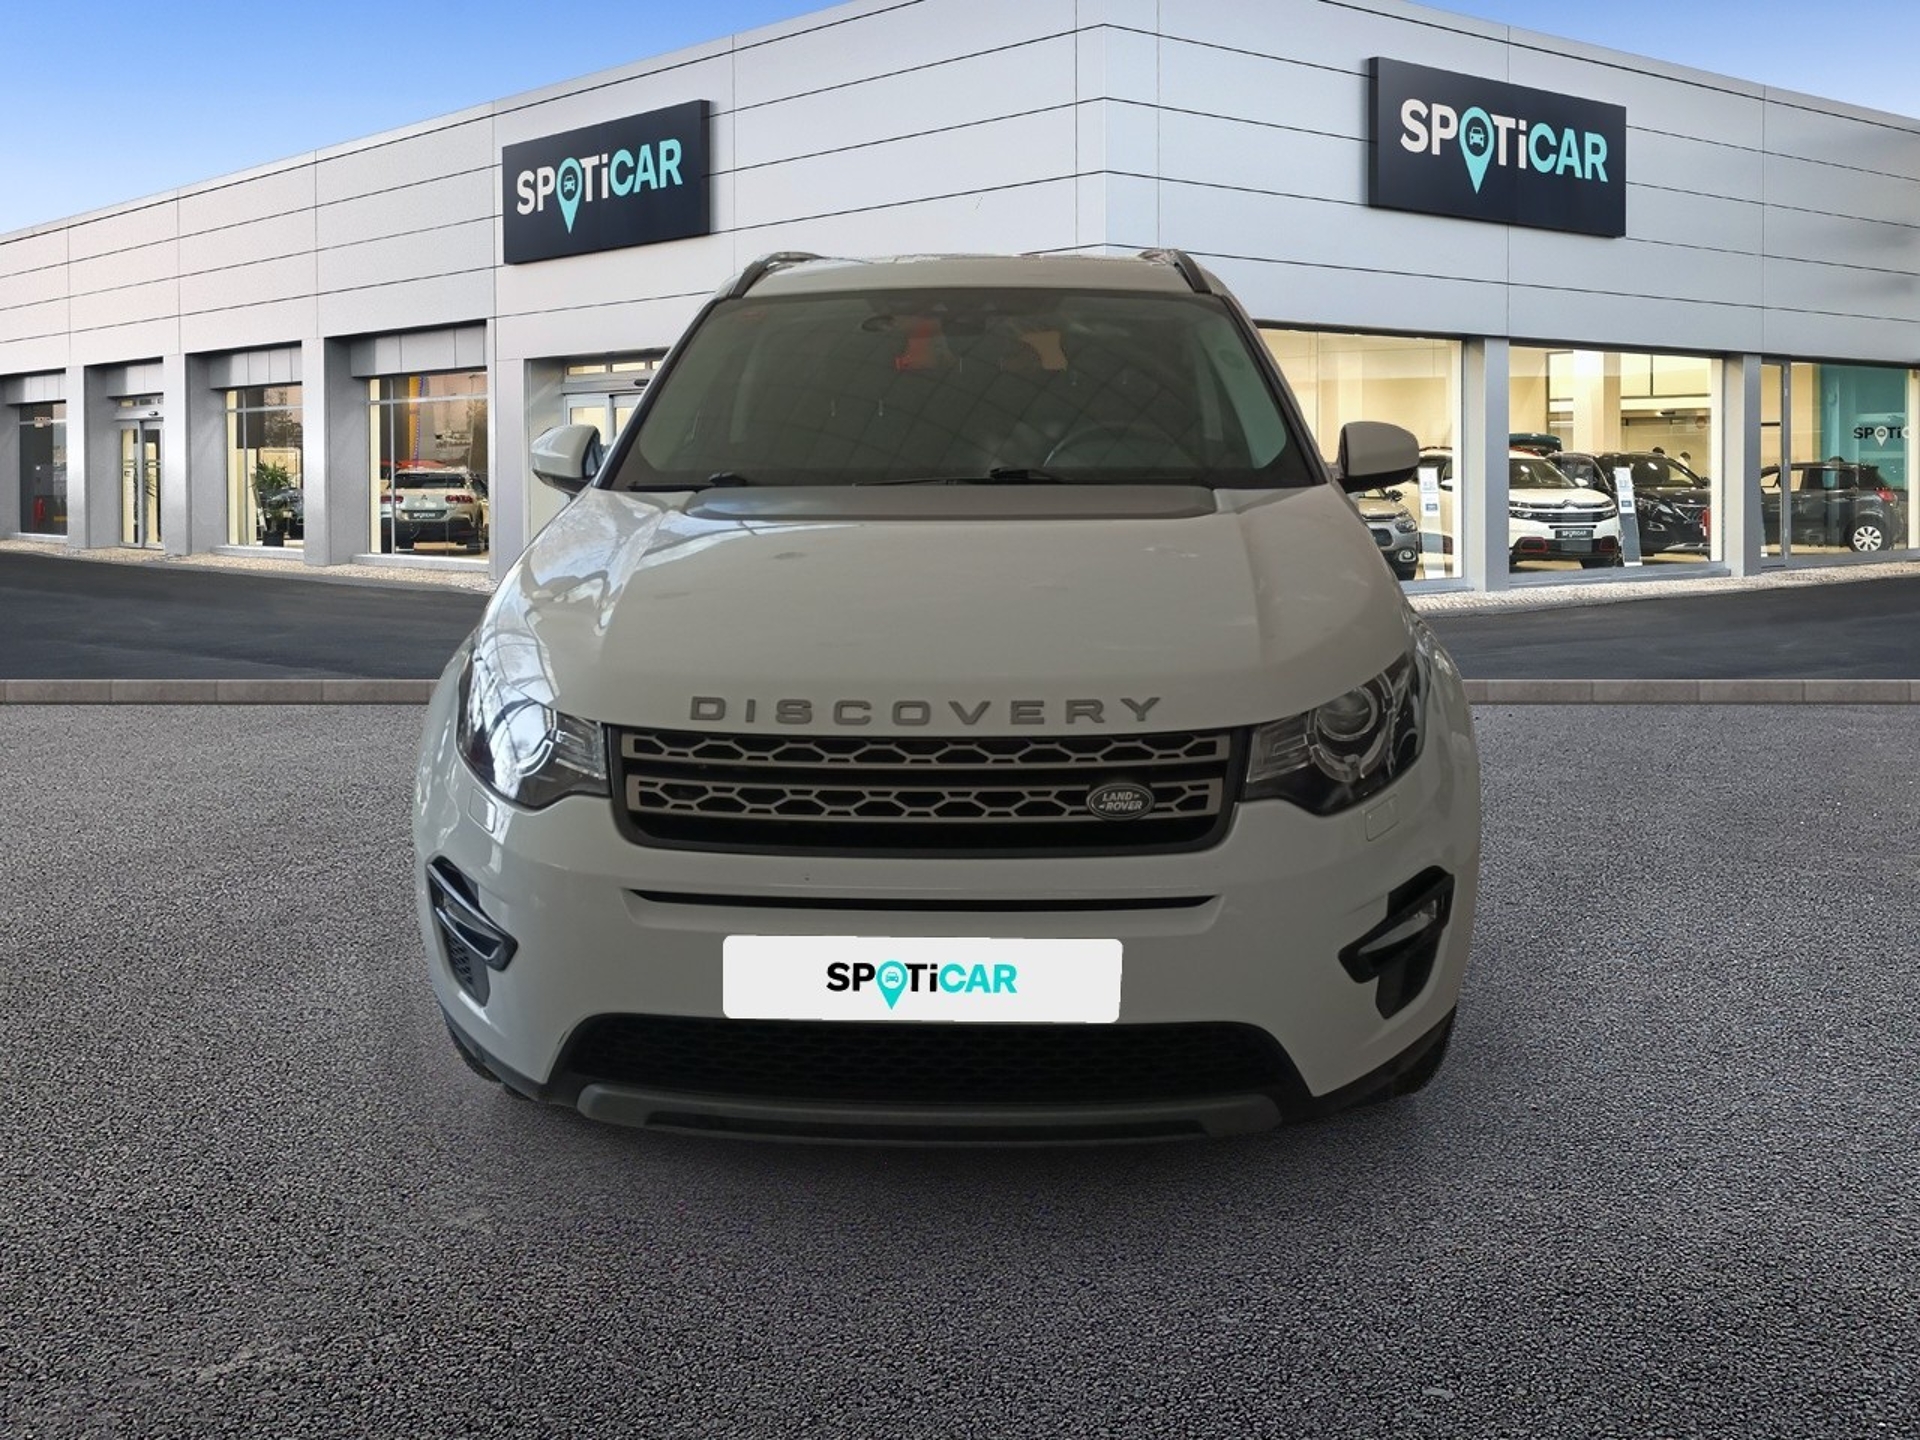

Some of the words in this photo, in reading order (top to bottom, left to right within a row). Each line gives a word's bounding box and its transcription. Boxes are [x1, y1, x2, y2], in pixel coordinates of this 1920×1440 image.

[690, 696, 1161, 726] DISCOVERY
[1102, 791, 1133, 802] LAND
[1105, 800, 1143, 811] ROVER
